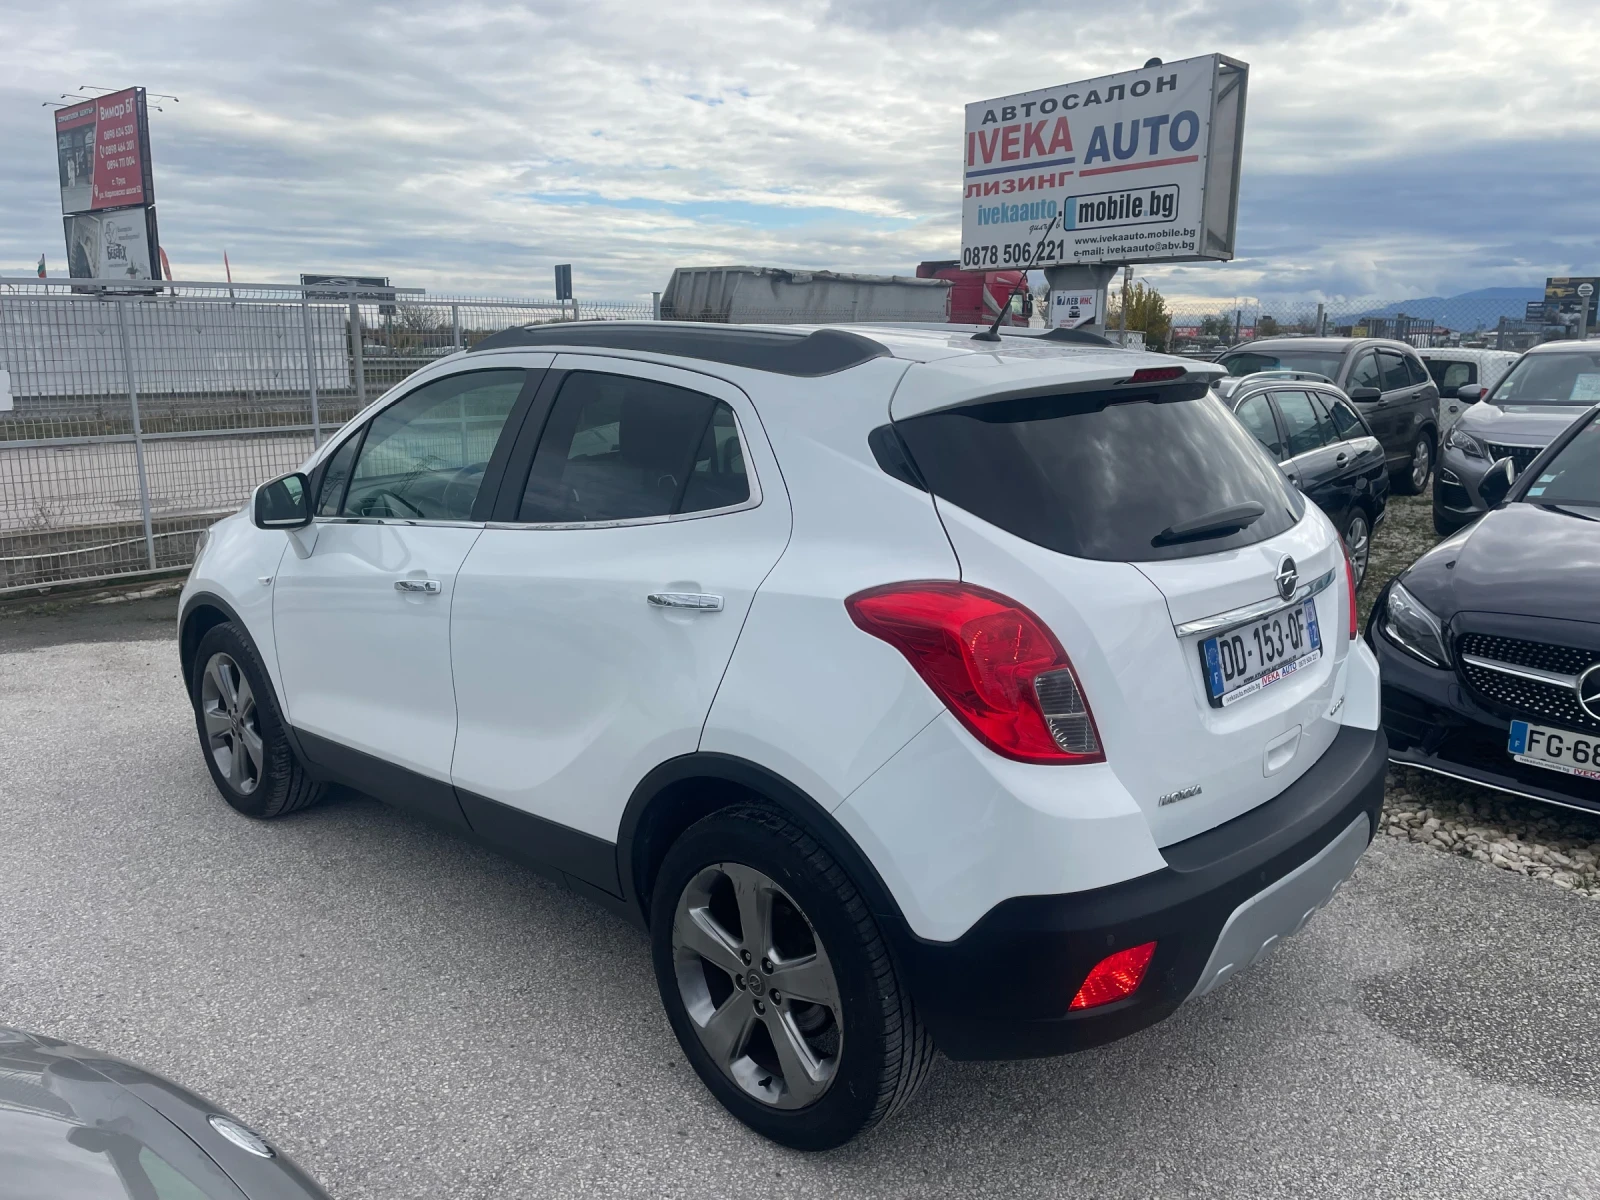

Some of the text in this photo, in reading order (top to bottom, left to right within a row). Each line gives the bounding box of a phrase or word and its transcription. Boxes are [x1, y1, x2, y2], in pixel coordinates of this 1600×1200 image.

[100, 97, 134, 120] Вимар БГ
[981, 73, 1177, 125] АВТОСАЛОН
[126, 139, 135, 150] 201
[967, 109, 1200, 167] IVEKA AUTO
[965, 170, 1075, 199] ЛИЗИНГ
[1078, 190, 1175, 224] mobile.bg
[1073, 240, 1195, 257] e-mail: ivekaauto@abv.bg
[1074, 228, 1196, 245] www.ivekaauto.mobile.bg
[963, 239, 1064, 266] 0878 506 221
[1213, 671, 1219, 684] F
[1261, 671, 1280, 686] IVEKA
[1281, 661, 1297, 676] AUTO
